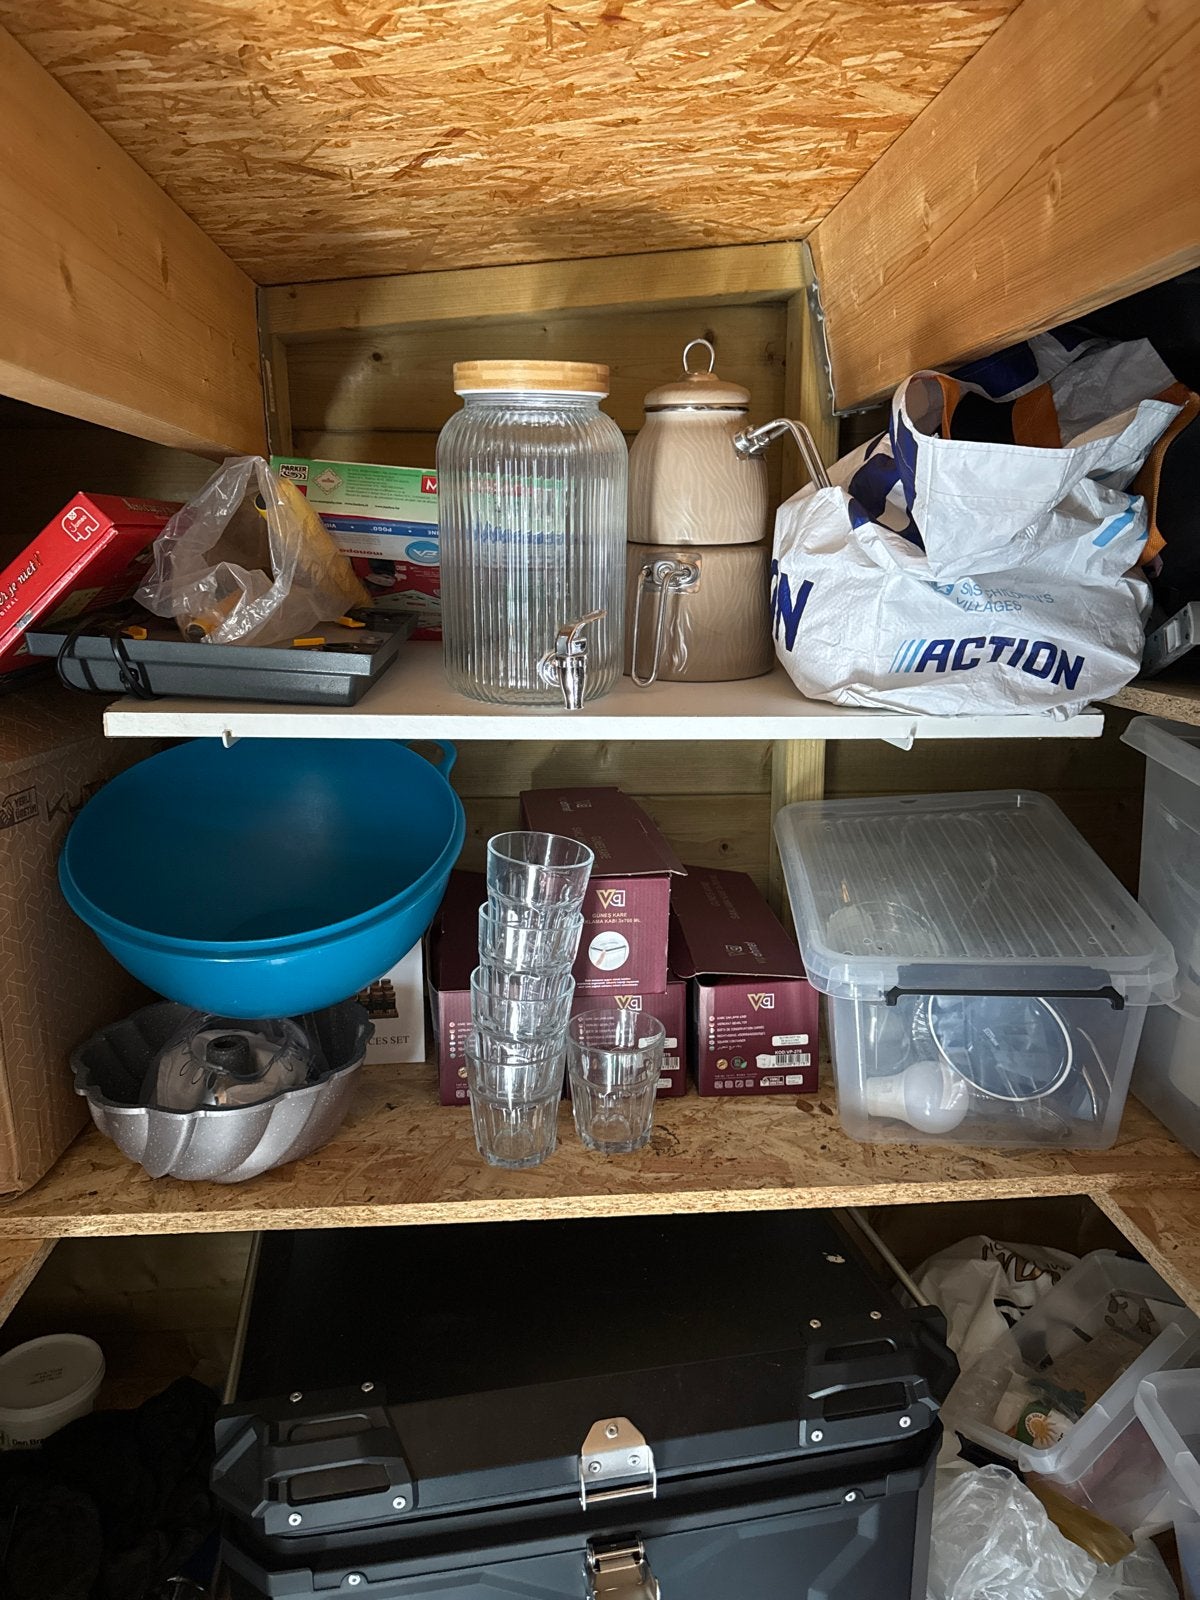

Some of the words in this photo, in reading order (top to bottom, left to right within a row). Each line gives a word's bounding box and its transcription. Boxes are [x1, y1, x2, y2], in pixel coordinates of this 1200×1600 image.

[280, 465, 308, 473] PARKER
[956, 597, 1022, 613] VILLAGES
[916, 636, 1085, 690] ACTION
[390, 1034, 410, 1045] SET
